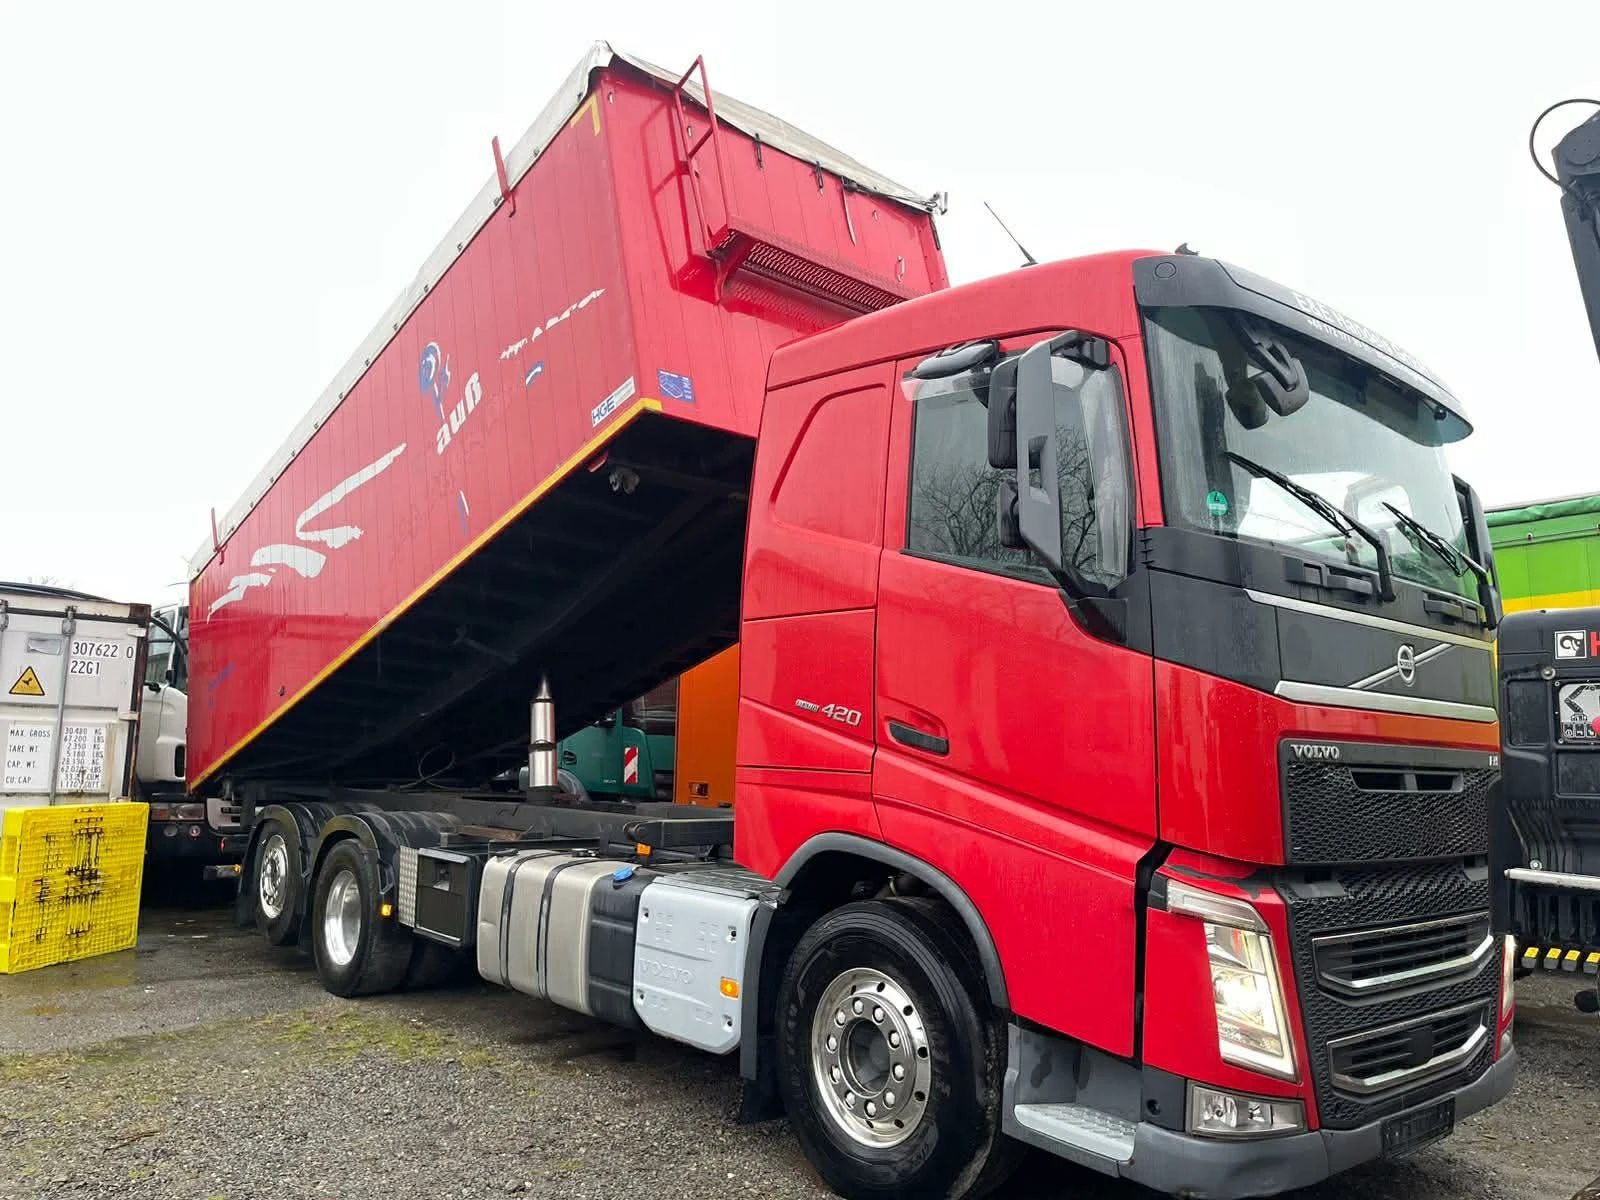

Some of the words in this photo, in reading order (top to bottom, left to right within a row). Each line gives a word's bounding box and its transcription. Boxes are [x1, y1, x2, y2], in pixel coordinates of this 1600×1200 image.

[592, 394, 616, 425] HGE
[72, 642, 119, 658] 307622
[70, 660, 100, 675] 22G1
[821, 703, 862, 726] 420
[29, 728, 51, 738] GROSS
[9, 744, 25, 753] TARE
[1290, 743, 1341, 760] VOLVO
[638, 957, 694, 985] VOLVO
